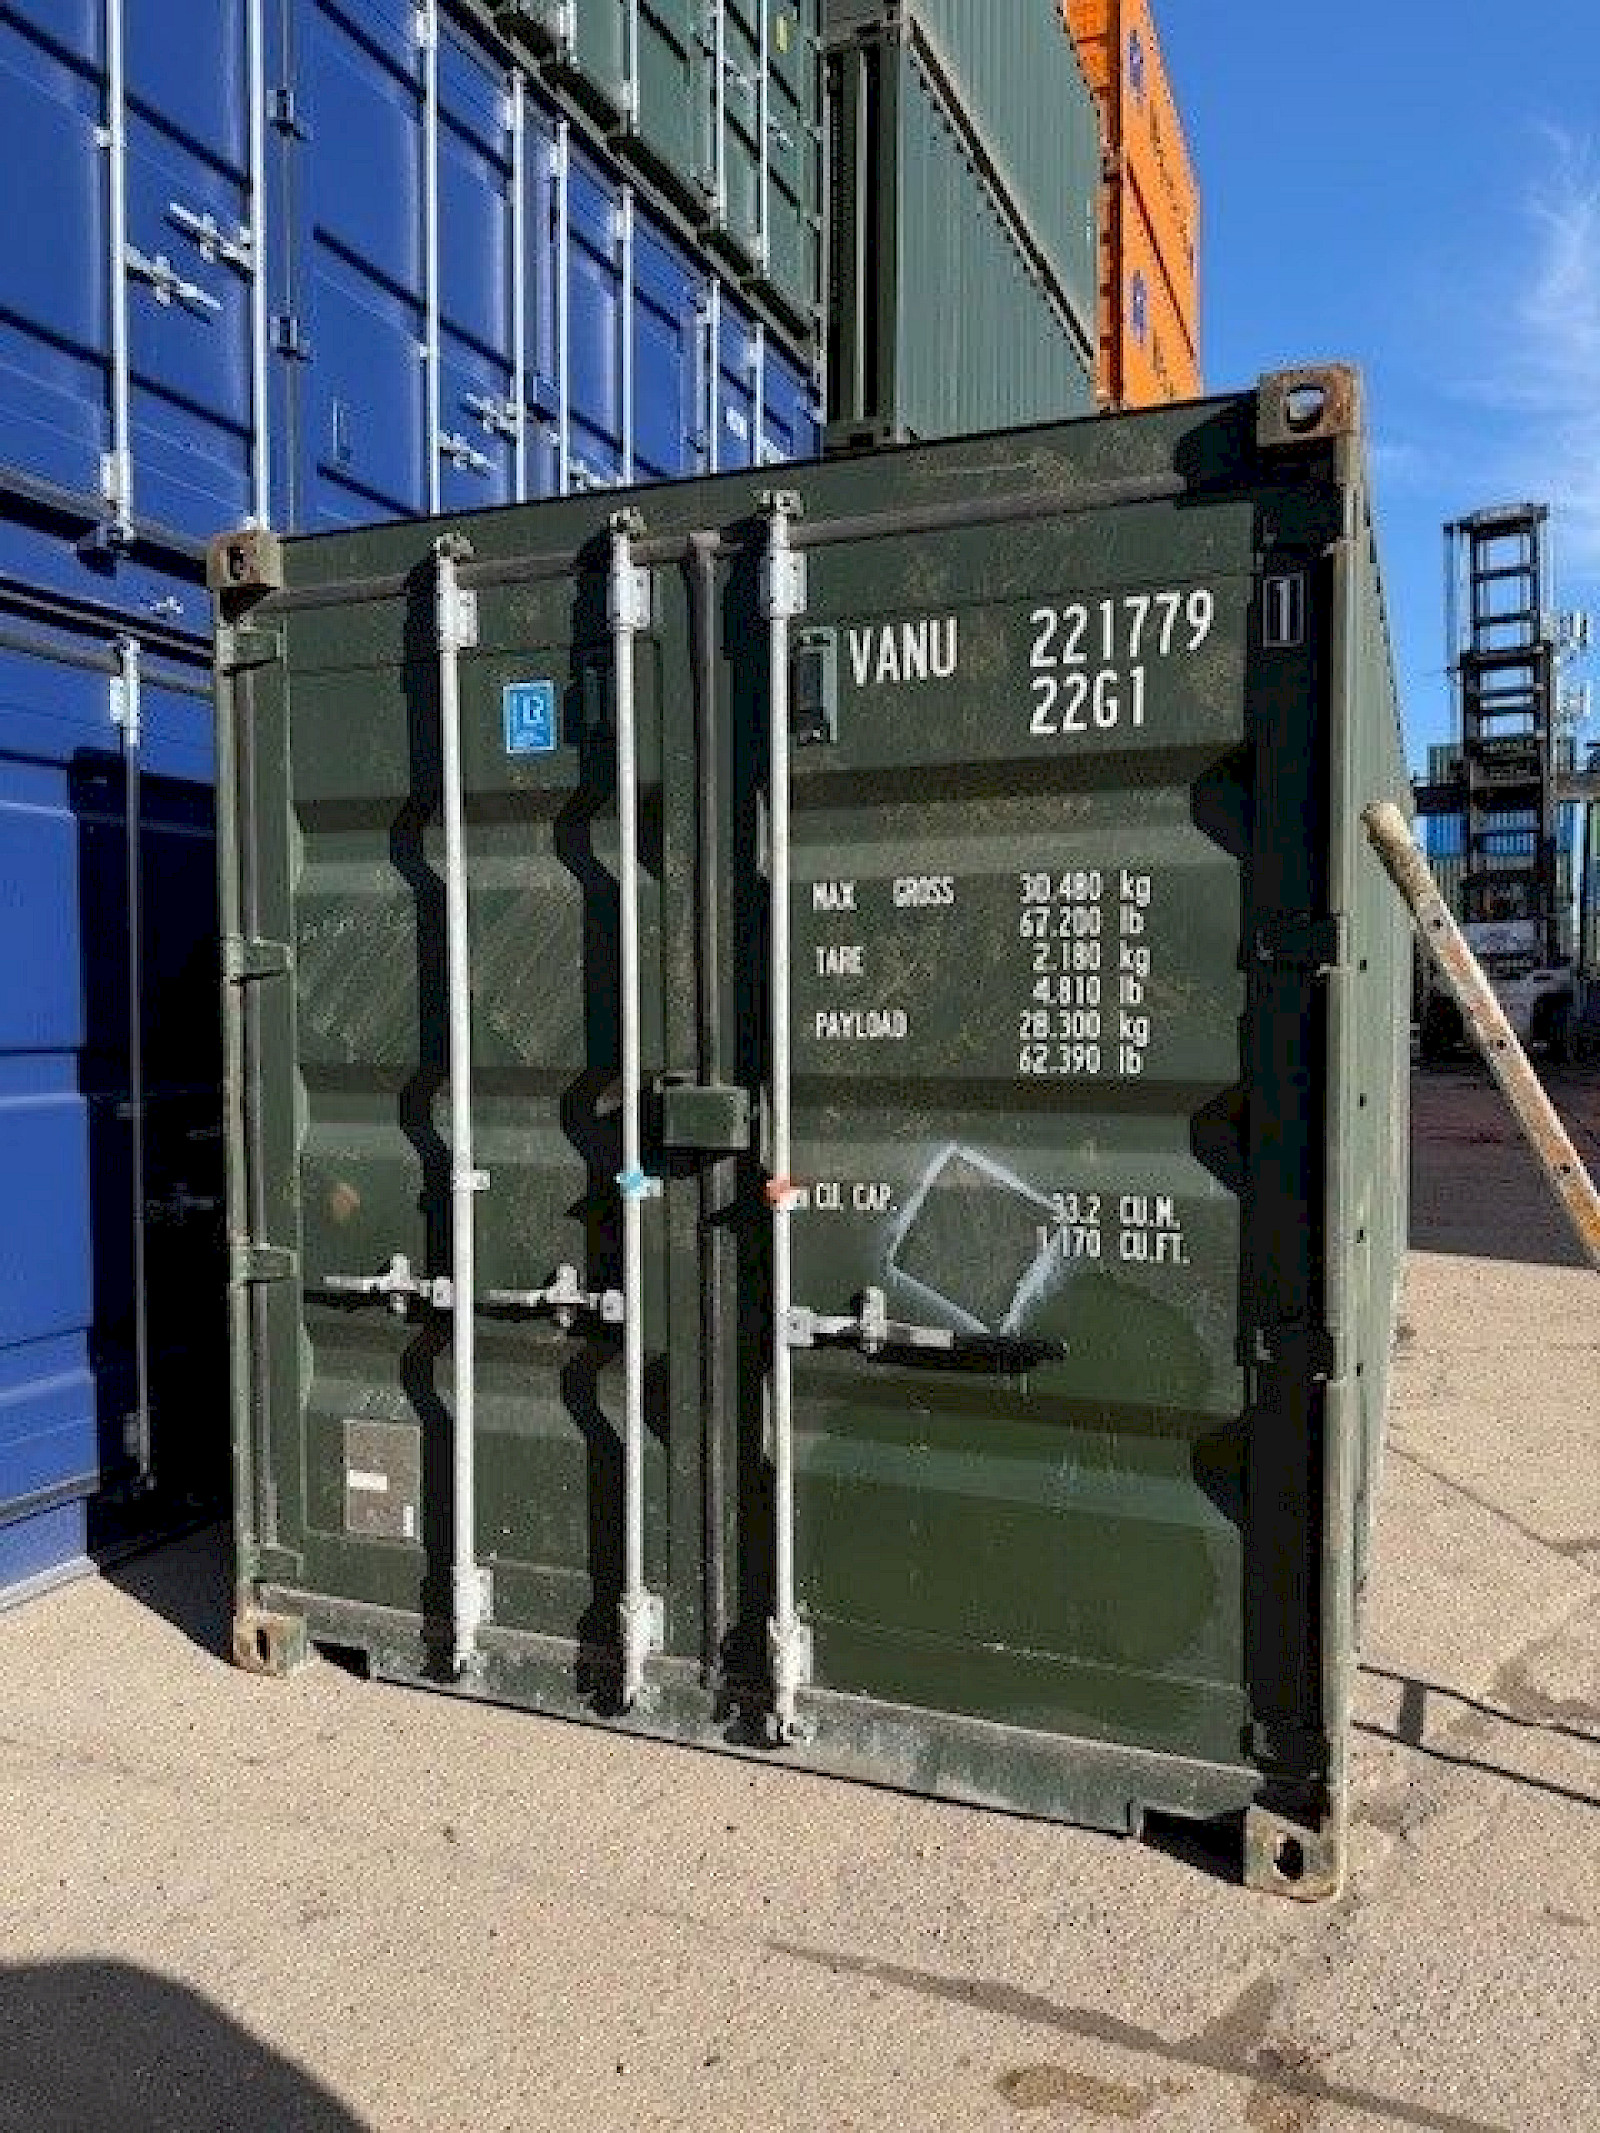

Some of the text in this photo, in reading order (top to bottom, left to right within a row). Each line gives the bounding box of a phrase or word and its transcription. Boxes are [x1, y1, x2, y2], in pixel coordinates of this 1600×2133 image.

[848, 618, 958, 687] VANU
[1030, 589, 1214, 668] 221779
[1030, 665, 1145, 734] 22G1
[813, 880, 857, 911] MAX
[893, 876, 955, 907] GROSS
[1120, 869, 1151, 907] kg
[1020, 904, 1144, 937] 67.200 lb
[816, 945, 863, 977] TARE
[1120, 939, 1151, 977] kg
[1033, 975, 1144, 1006] 4.810 lb
[816, 1009, 1151, 1047] PAYLOAD 28.300 kg
[1020, 1043, 1144, 1073] 62.390 lb
